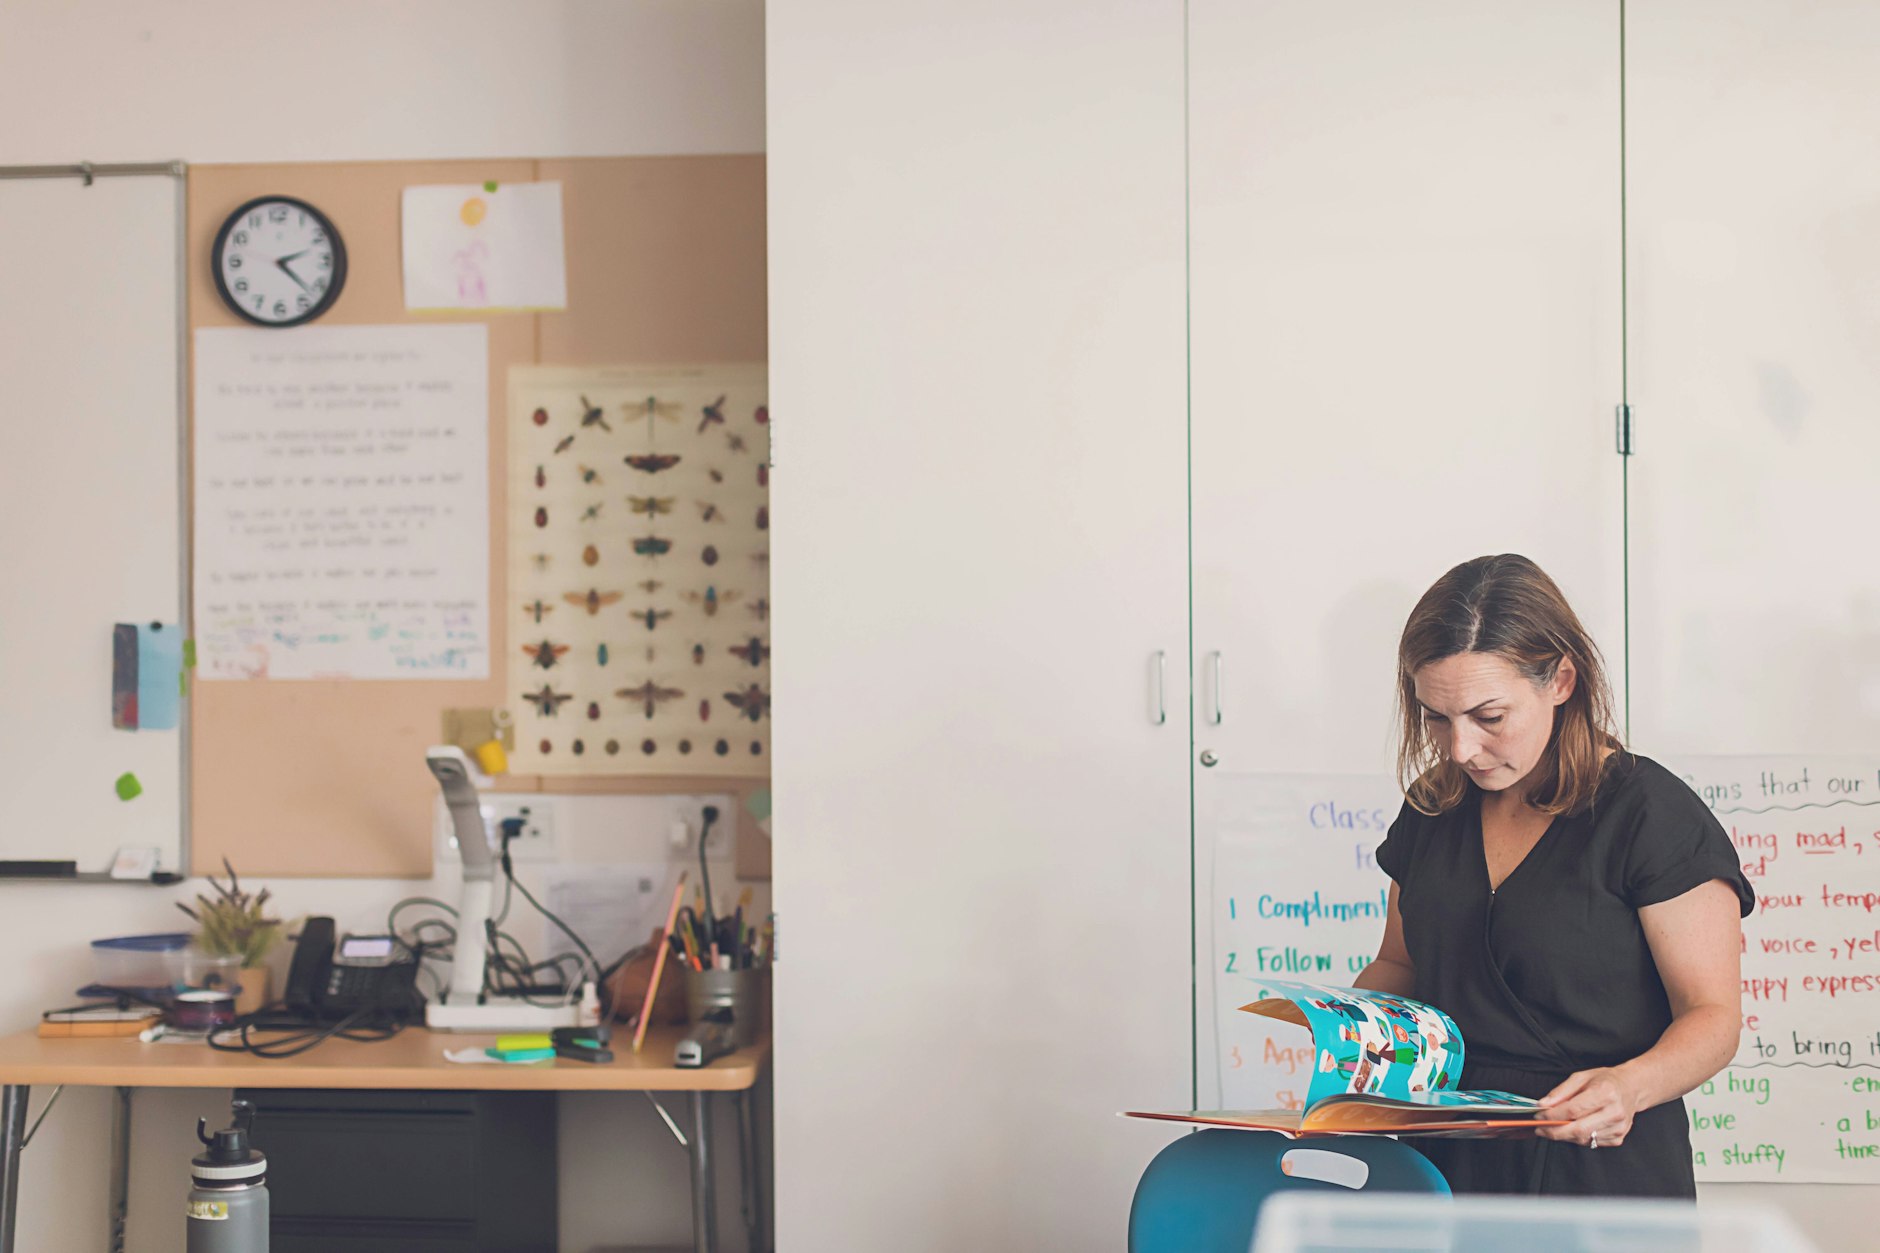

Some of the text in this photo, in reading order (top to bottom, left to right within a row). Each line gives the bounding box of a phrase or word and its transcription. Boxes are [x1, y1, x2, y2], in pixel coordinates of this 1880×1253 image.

[1760, 768, 1811, 797] that
[1828, 778, 1864, 793] our
[1309, 801, 1386, 831] Class
[1757, 895, 1803, 914] your
[1225, 952, 1239, 973] 2
[1257, 946, 1332, 974] Follow
[1752, 1036, 1777, 1058] to
[1793, 1030, 1852, 1068] bring
[1728, 1071, 1770, 1105] hug
[1692, 1108, 1737, 1132] love
[1837, 1118, 1851, 1132] a
[1695, 1142, 1785, 1174] a stuffy
